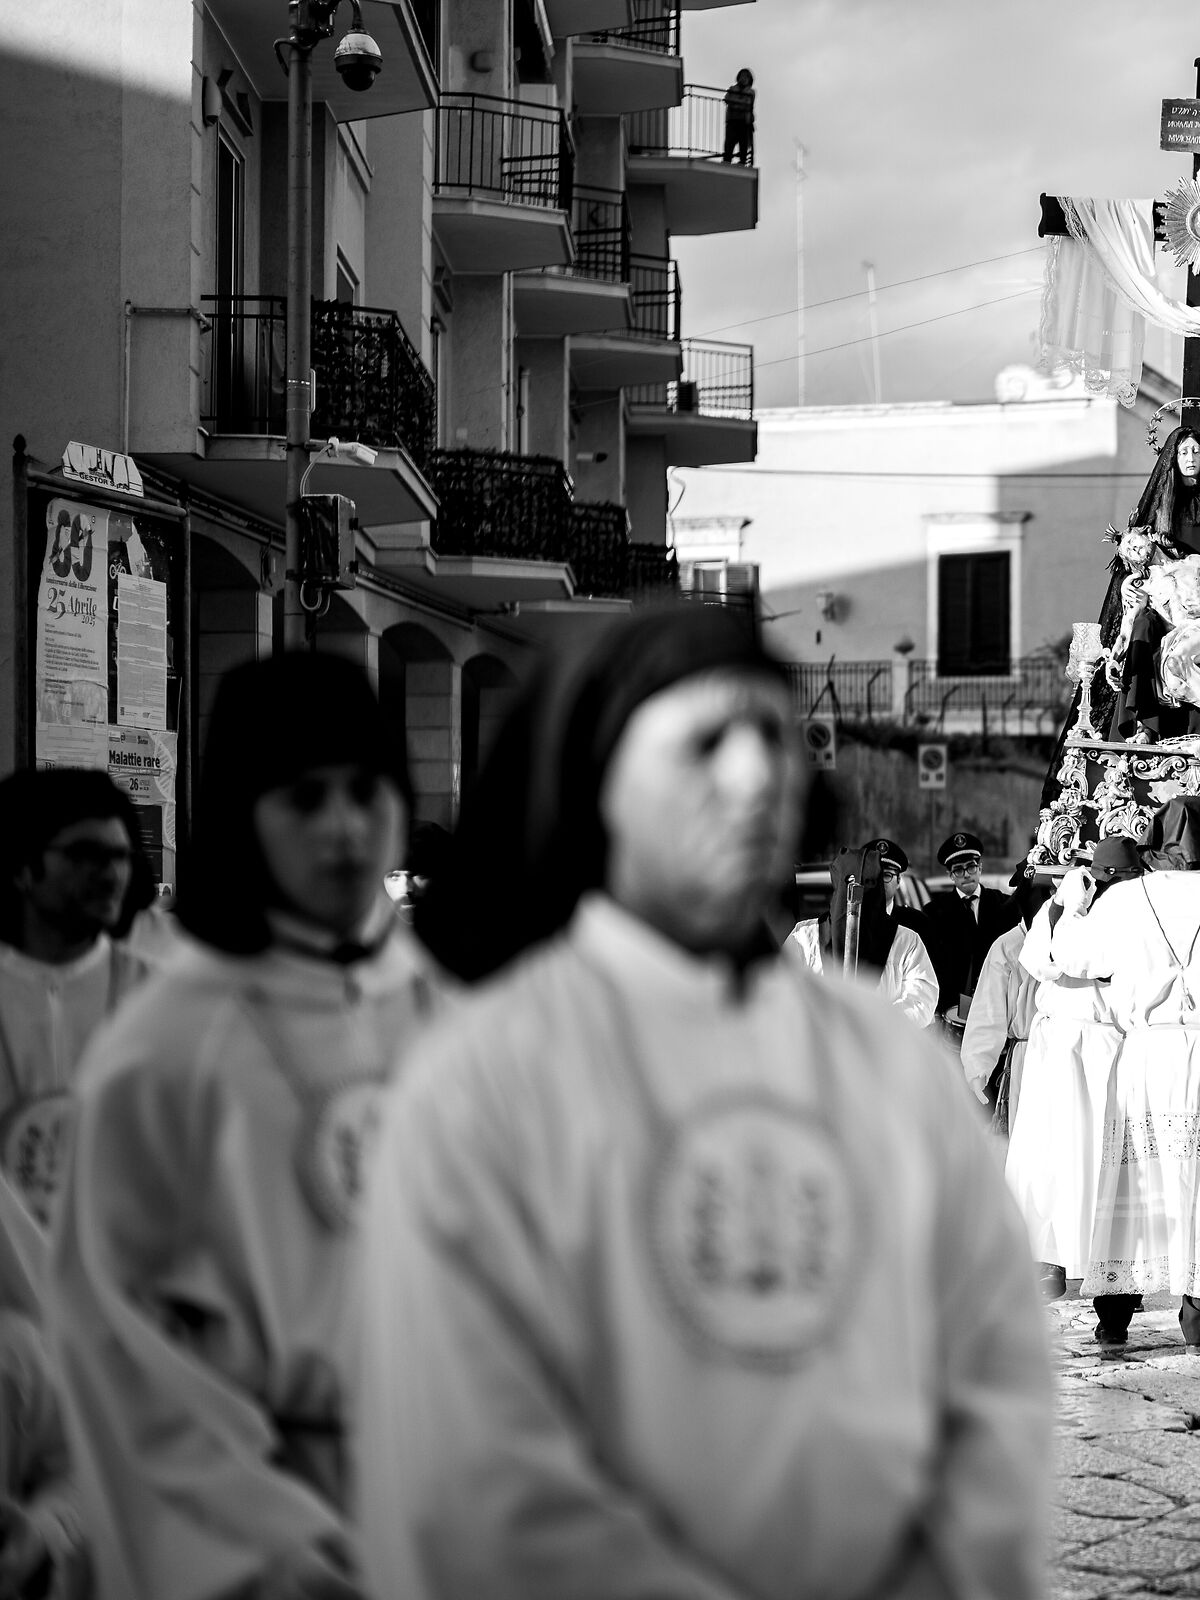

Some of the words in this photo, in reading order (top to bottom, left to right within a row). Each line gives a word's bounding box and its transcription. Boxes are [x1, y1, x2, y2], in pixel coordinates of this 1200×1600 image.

[47, 587, 66, 620] 25
[108, 749, 142, 767] Malattie
[143, 756, 161, 768] rare
[129, 777, 139, 791] 26
